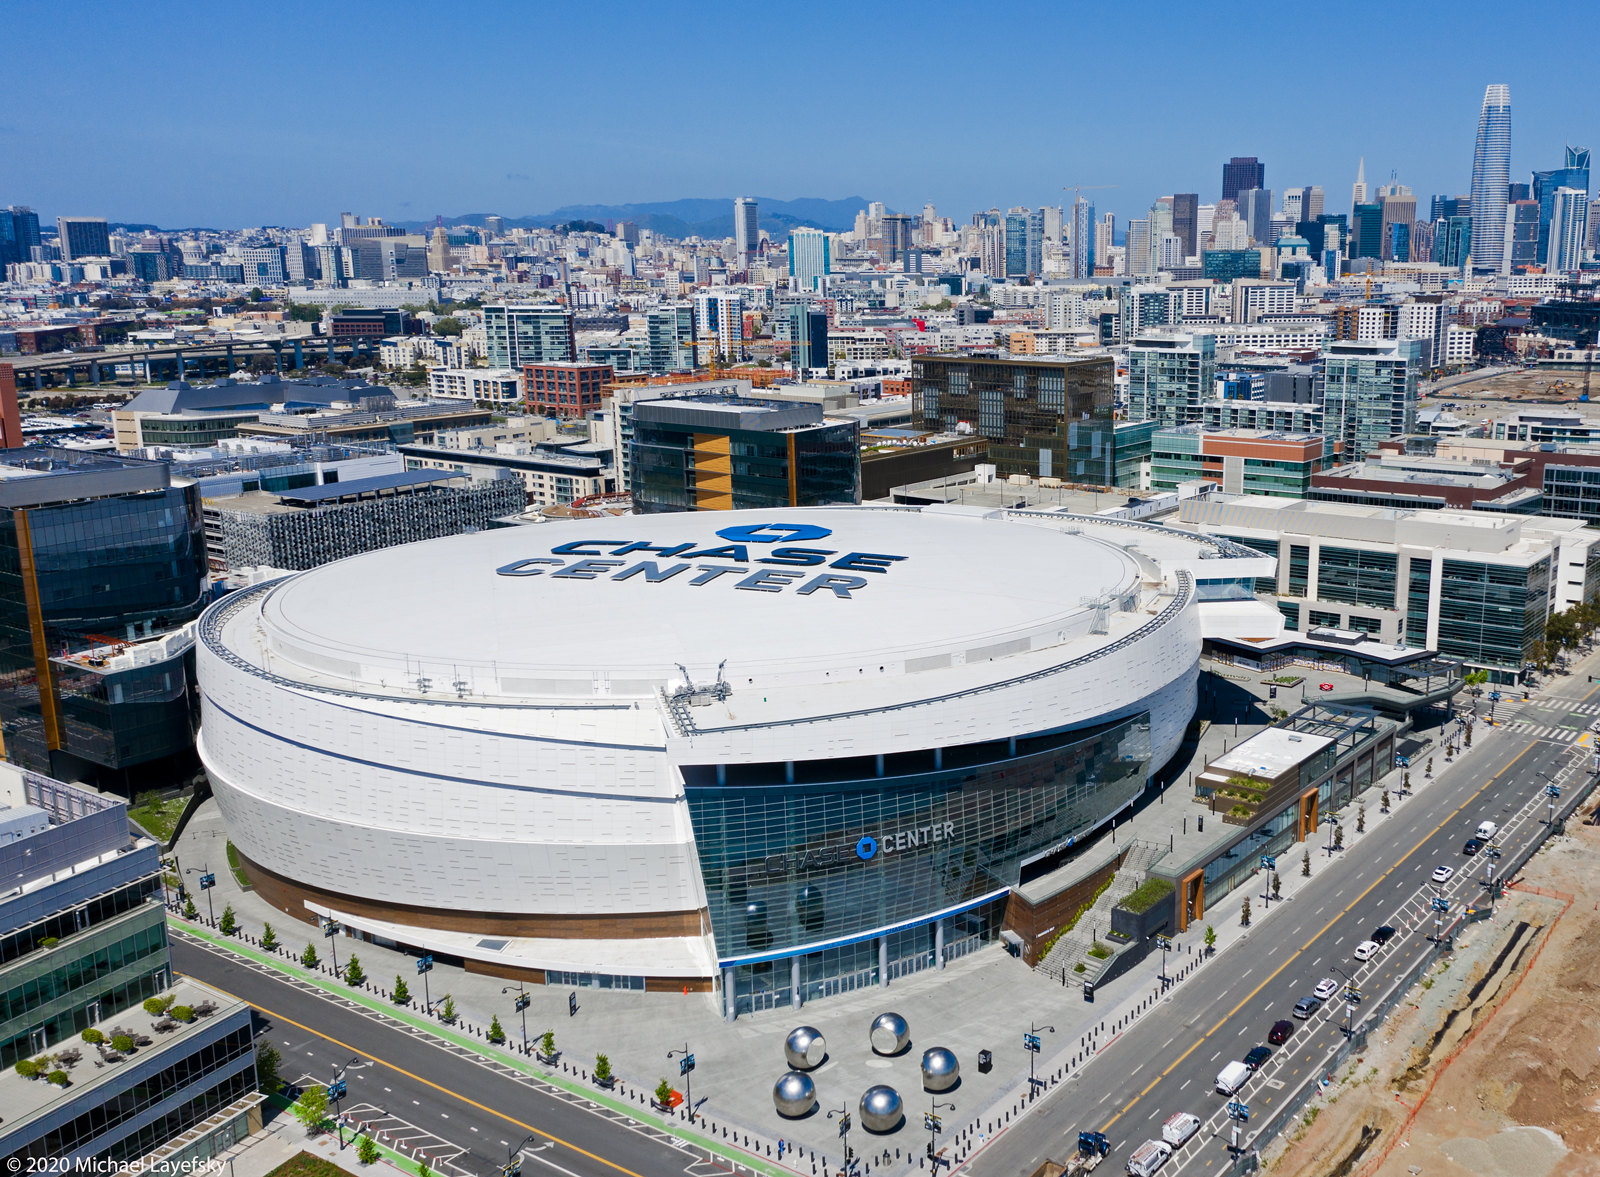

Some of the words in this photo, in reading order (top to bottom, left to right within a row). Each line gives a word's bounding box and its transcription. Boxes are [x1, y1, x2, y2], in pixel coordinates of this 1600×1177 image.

[551, 540, 909, 573] CHASE
[496, 558, 867, 599] CENTER
[765, 844, 850, 873] CHASE
[882, 821, 955, 853] CENTER
